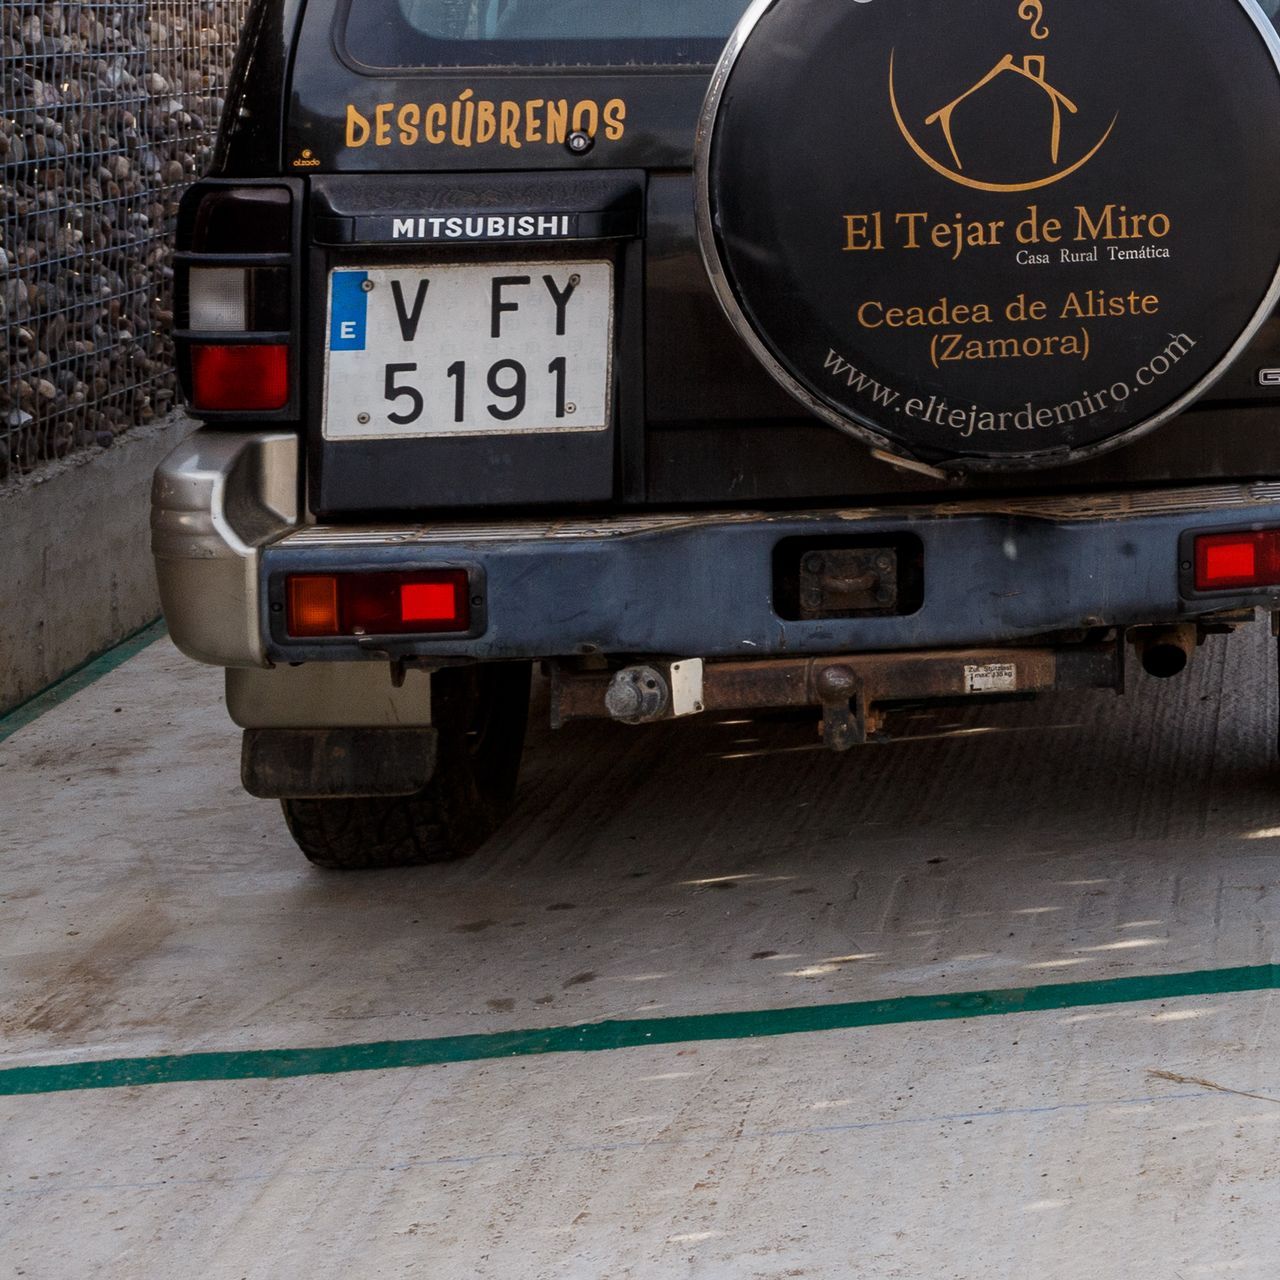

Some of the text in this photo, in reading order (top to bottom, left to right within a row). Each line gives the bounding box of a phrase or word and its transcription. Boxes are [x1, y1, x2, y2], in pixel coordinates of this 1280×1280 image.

[346, 89, 626, 149] DESCÚBRENOS
[393, 216, 568, 238] MITSUBISHI
[844, 205, 1169, 259] El Tejar de Miro
[1016, 245, 1169, 264] Casa Rural Temática
[341, 322, 355, 338] E
[391, 274, 580, 341] V FY
[858, 291, 1158, 327] Ceadea de Aliste
[931, 328, 1088, 368] (Zamora)
[385, 357, 565, 424] 5191
[822, 332, 1197, 437] www.eltejardemiro.com
